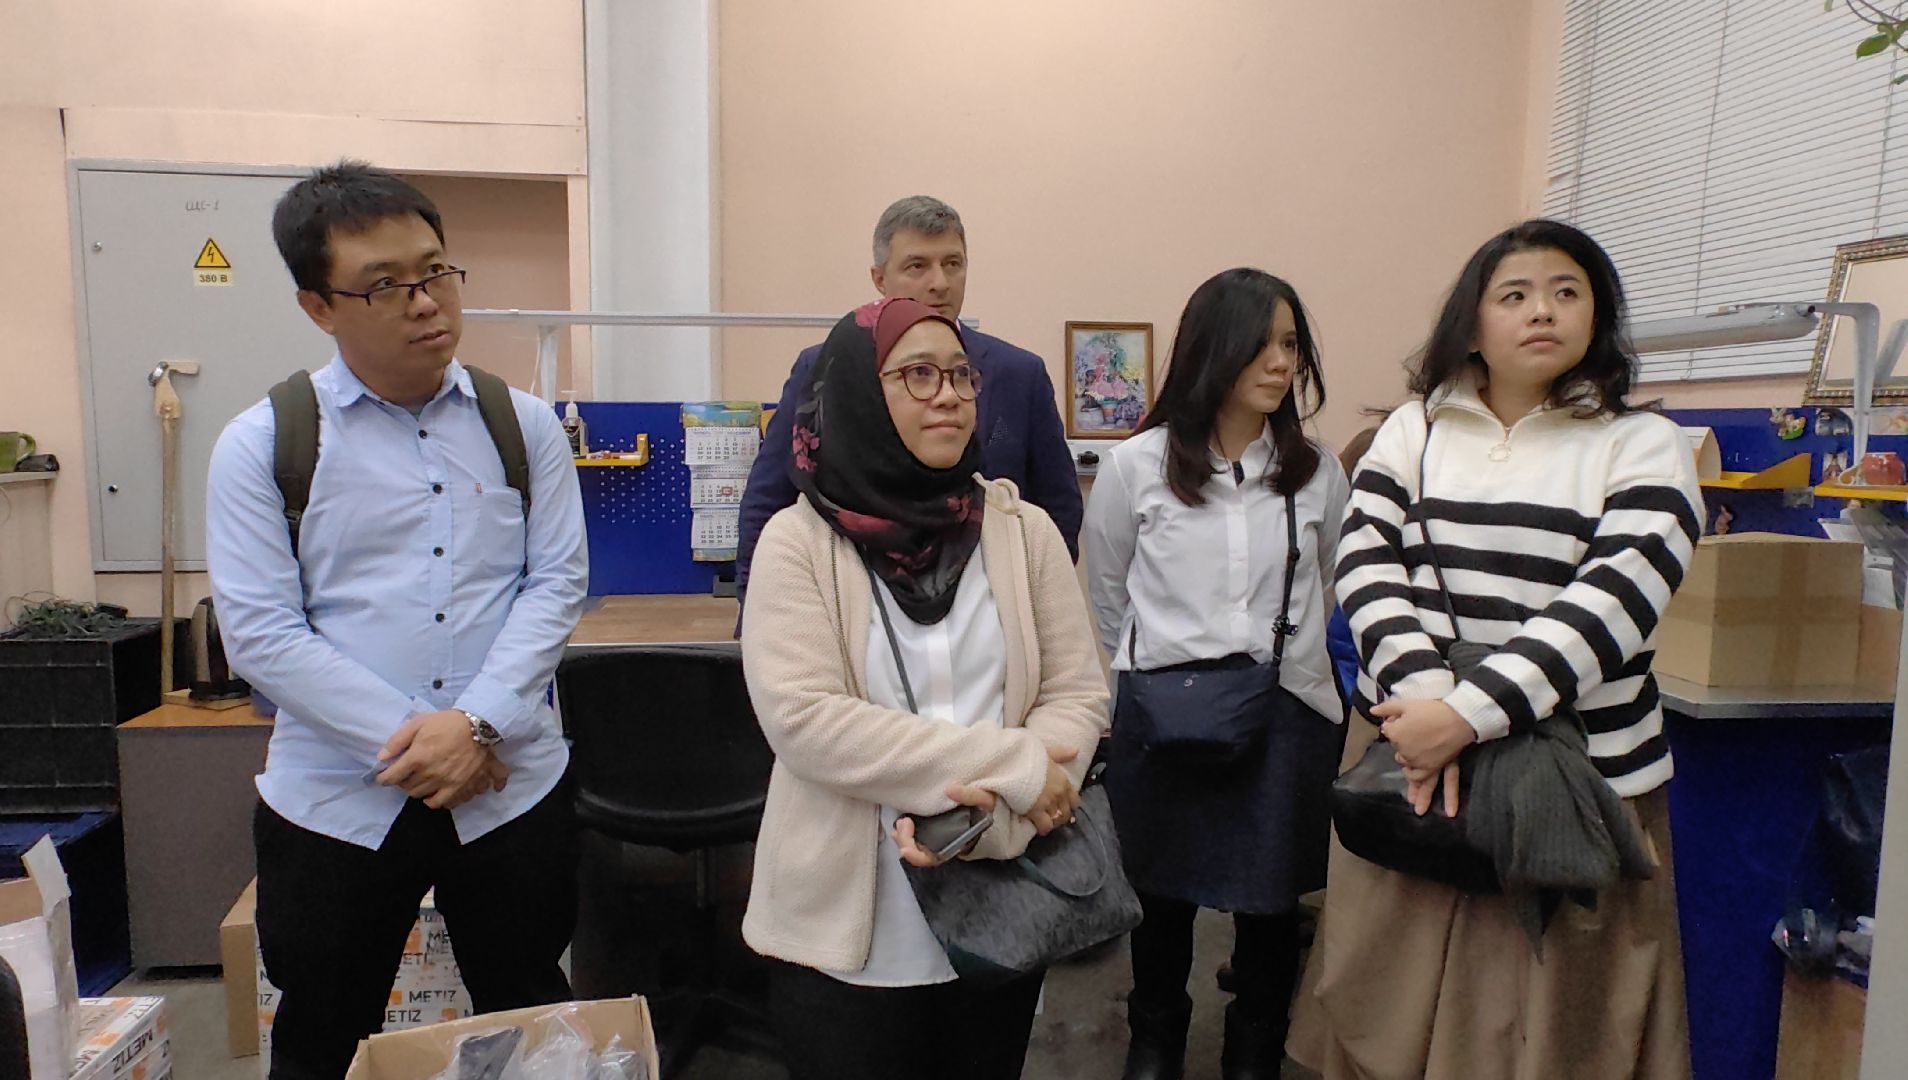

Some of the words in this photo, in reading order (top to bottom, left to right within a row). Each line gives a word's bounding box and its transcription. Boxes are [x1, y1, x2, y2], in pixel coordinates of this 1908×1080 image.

[199, 275, 217, 283] 380
[409, 990, 457, 1003] METIZ
[387, 1010, 421, 1023] ETIZ
